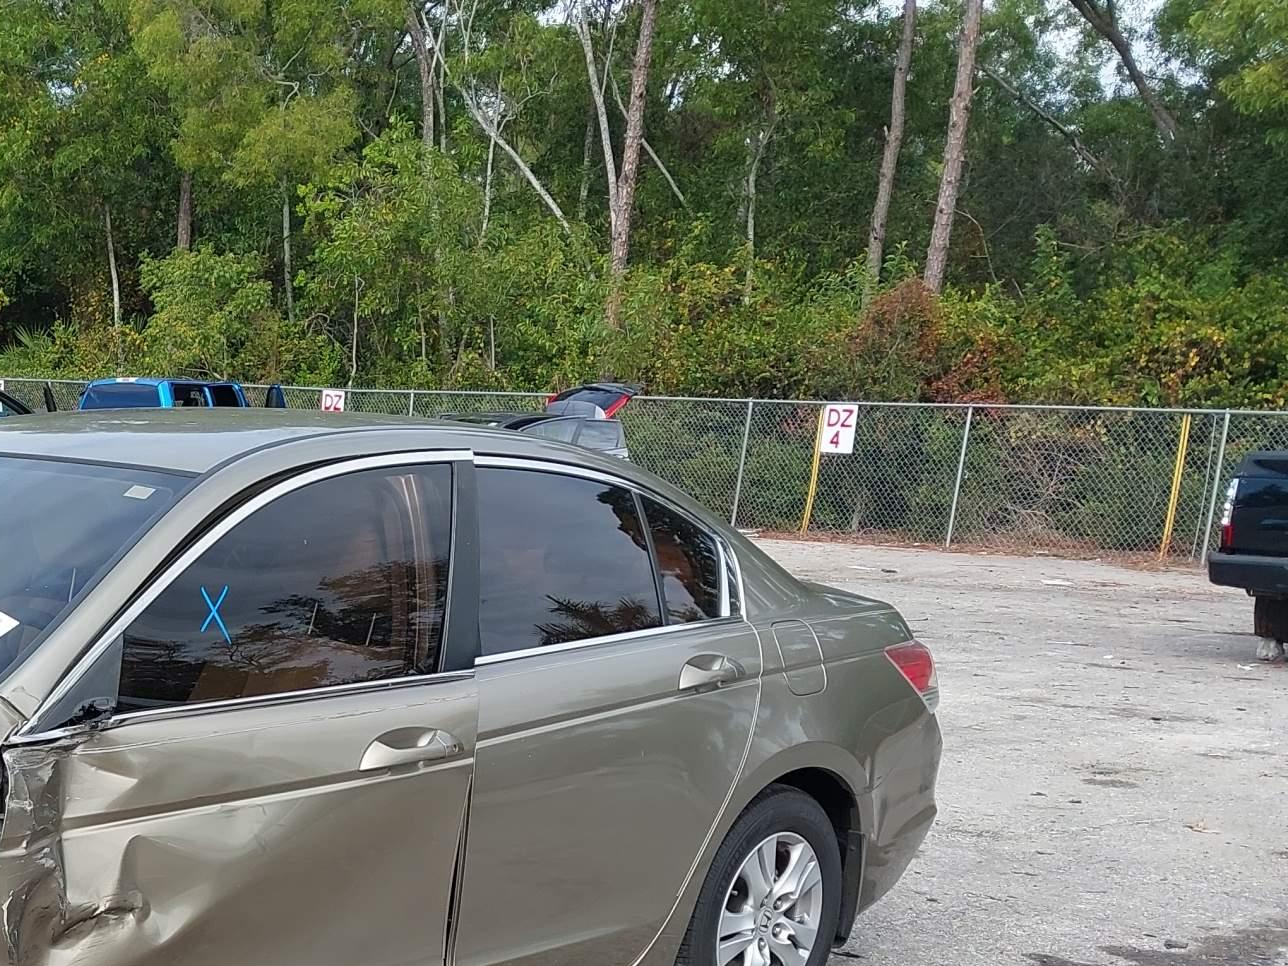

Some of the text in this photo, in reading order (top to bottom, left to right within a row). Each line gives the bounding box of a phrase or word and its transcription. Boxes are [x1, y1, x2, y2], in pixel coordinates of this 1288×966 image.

[324, 394, 342, 410] DZ
[827, 408, 854, 428] DZ
[829, 430, 840, 448] 4
